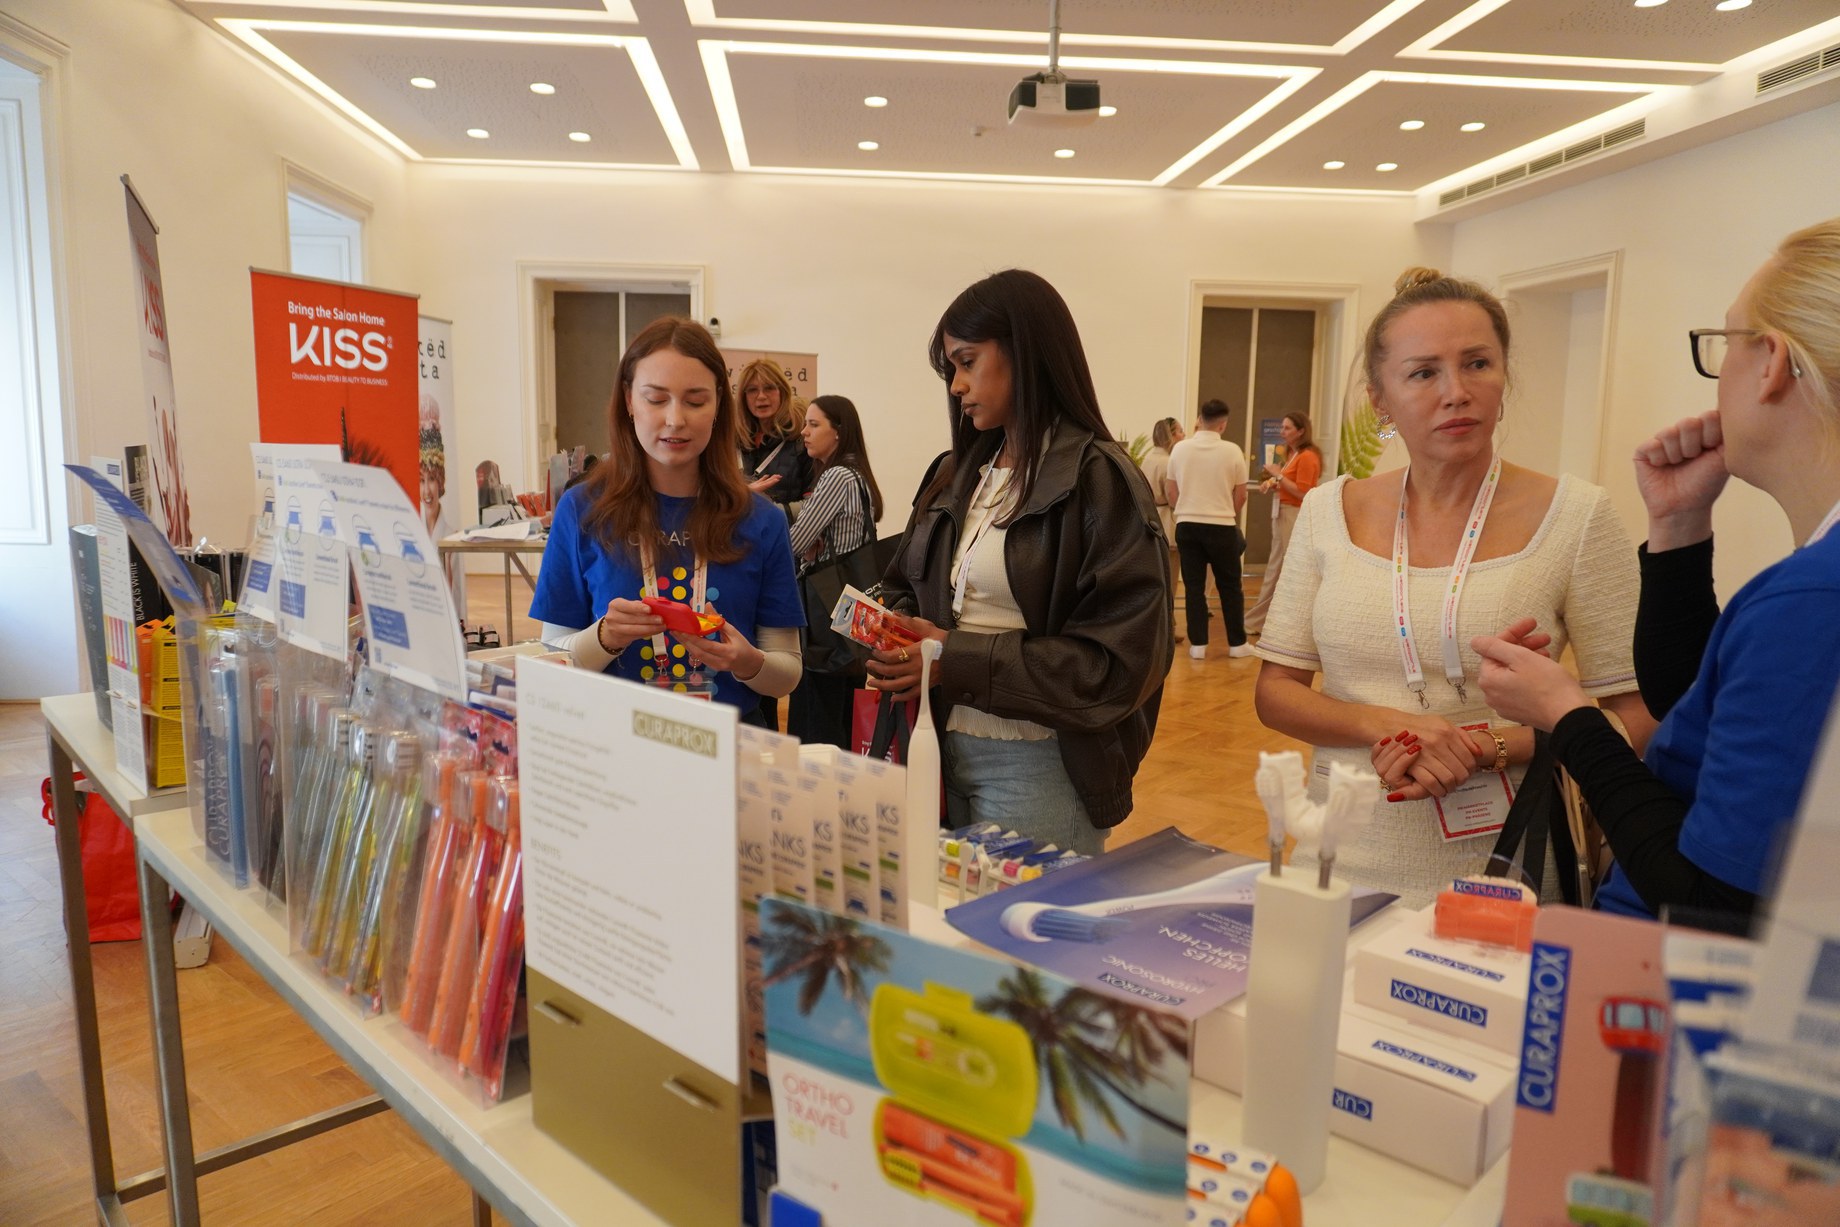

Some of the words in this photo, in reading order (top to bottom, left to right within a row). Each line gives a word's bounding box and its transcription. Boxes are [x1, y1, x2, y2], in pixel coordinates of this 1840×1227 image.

[288, 301, 314, 319] Bring
[316, 305, 332, 319] the
[333, 307, 358, 322] Salon
[359, 312, 385, 326] Home
[289, 322, 389, 372] KISS
[292, 372, 320, 381] Distributed
[130, 562, 139, 588] WHITE
[132, 588, 142, 596] IS
[135, 597, 145, 621] BLACK
[635, 713, 713, 753] CURAPROX
[1102, 954, 1206, 995] HYDROSONIC
[1182, 947, 1247, 973] HELLES
[1101, 974, 1181, 1006] CURAPROX
[1393, 982, 1484, 1024] CURAPROX
[1521, 948, 1567, 1107] CURAPROX
[783, 1073, 855, 1117] ORTHO
[788, 1096, 849, 1139] TRAVEL
